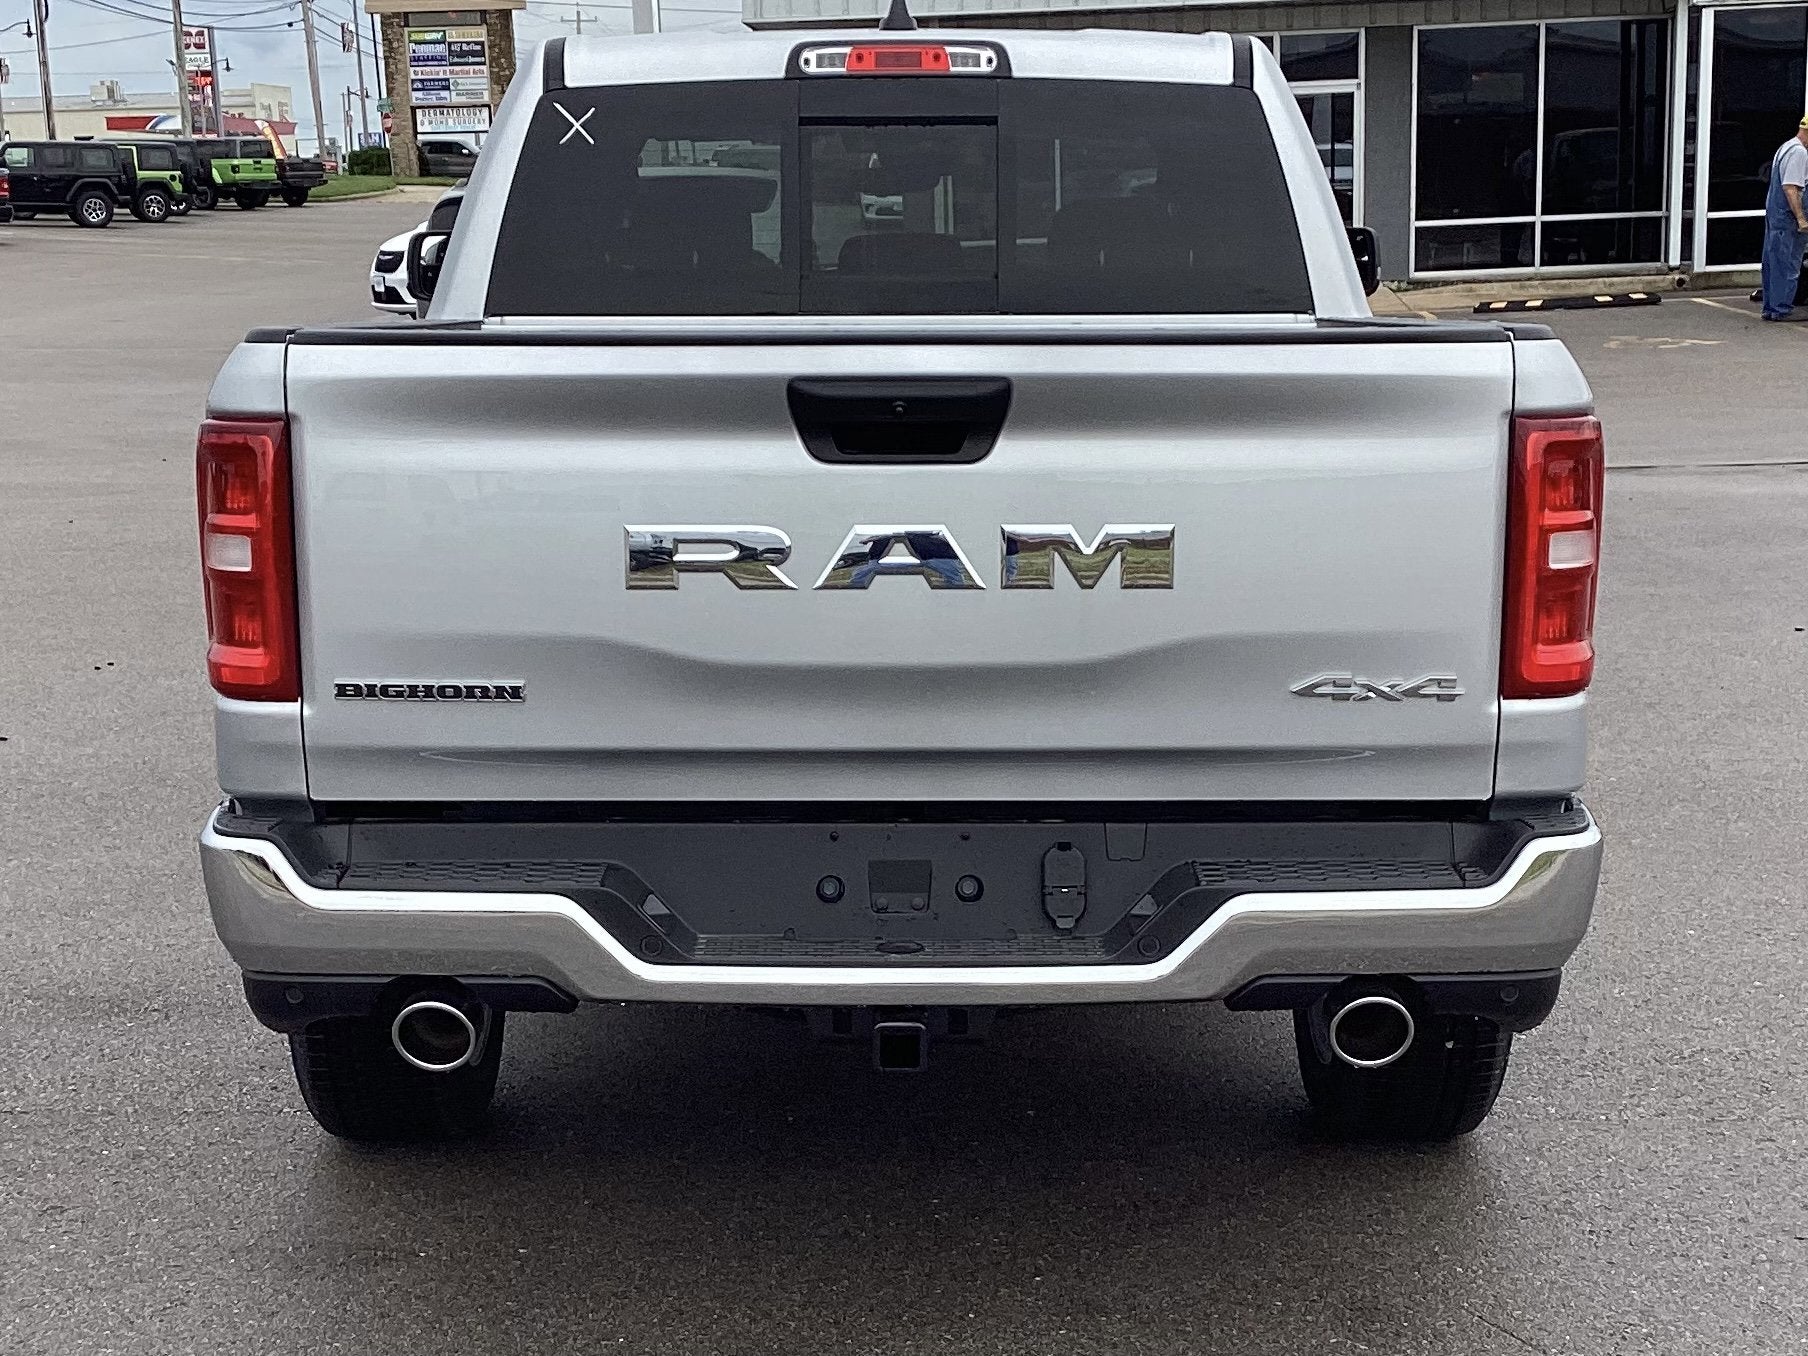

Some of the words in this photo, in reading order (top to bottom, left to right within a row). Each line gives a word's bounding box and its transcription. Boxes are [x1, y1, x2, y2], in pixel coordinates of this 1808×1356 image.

[421, 108, 483, 118] DERMATOLOGY
[623, 523, 1176, 590] RAM
[333, 677, 527, 702] BIGHORN
